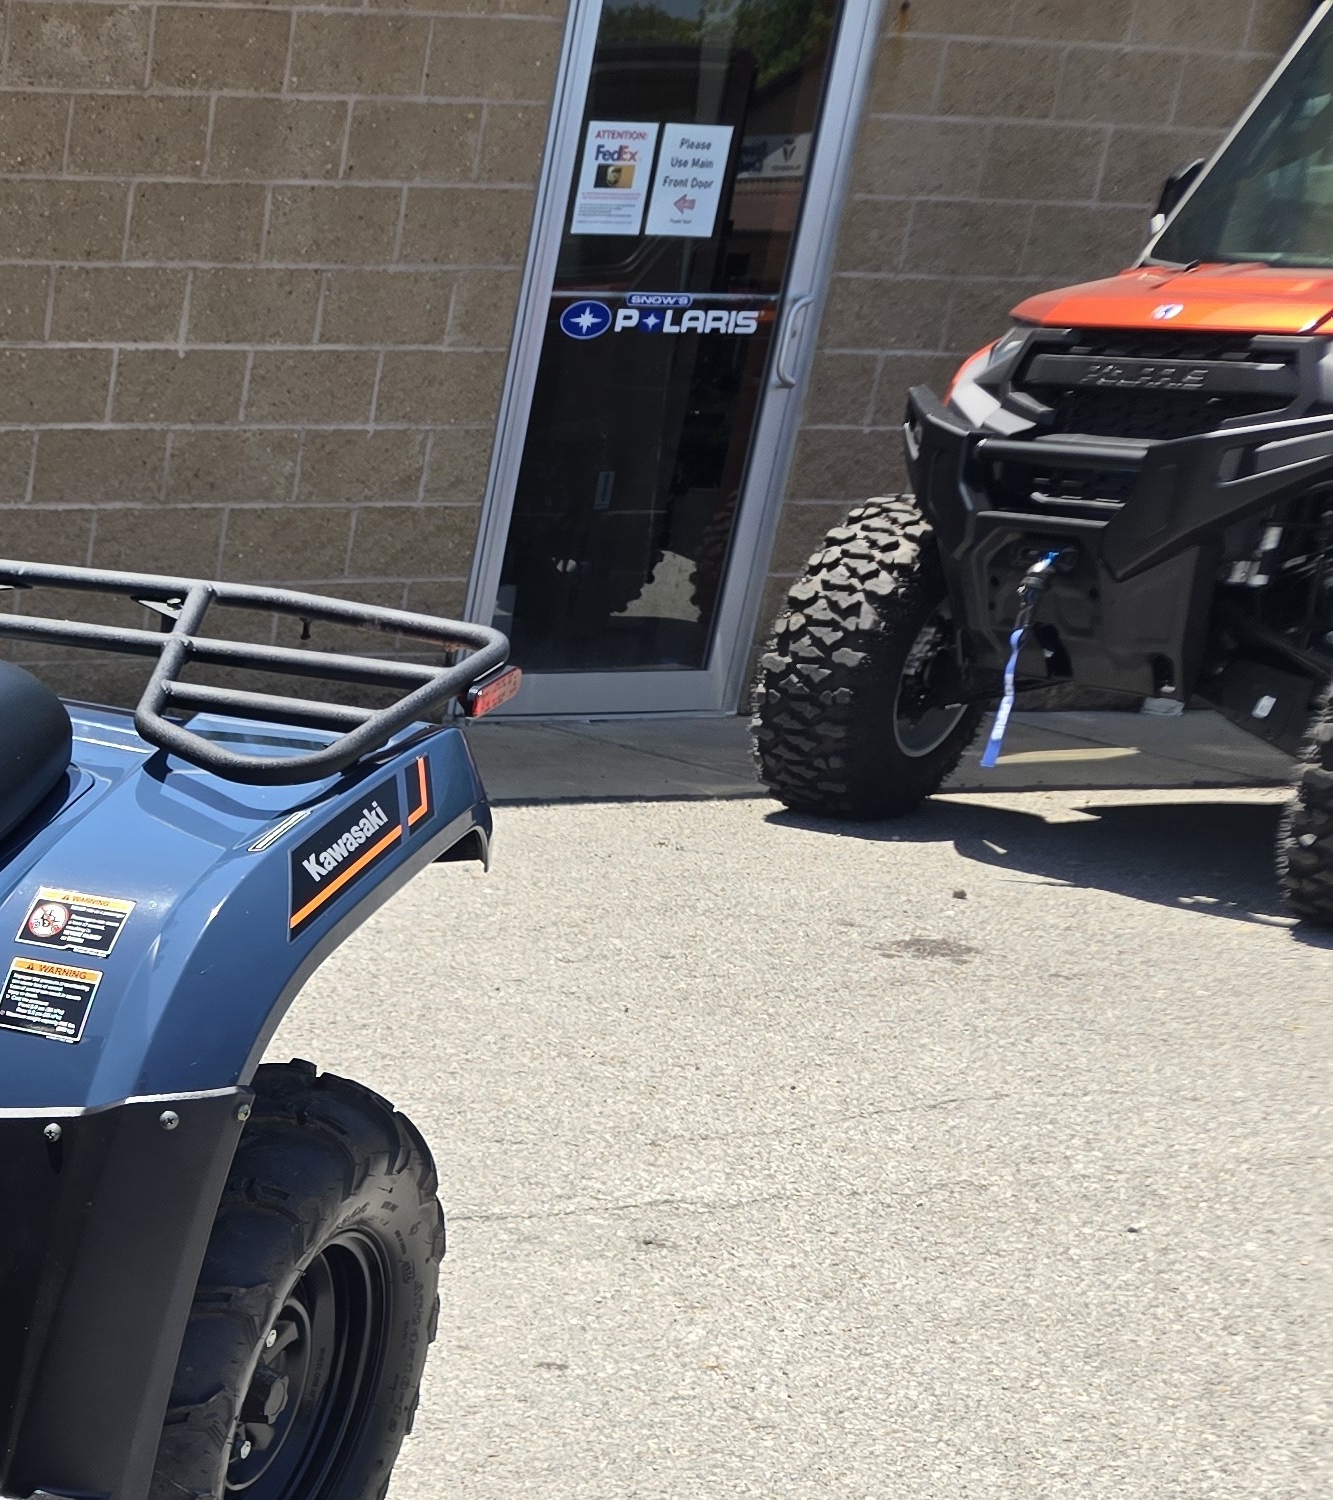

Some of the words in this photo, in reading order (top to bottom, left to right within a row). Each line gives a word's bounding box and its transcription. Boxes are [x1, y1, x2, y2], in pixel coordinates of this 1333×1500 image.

[679, 138, 712, 150] Please
[594, 144, 638, 162] FedEx
[670, 157, 688, 169] Use
[691, 157, 714, 169] Main
[662, 176, 688, 188] Front
[690, 176, 715, 189] Door
[630, 295, 689, 305] SNOW'S
[301, 800, 389, 883] Kawasaki
[39, 964, 87, 980] WARNING
